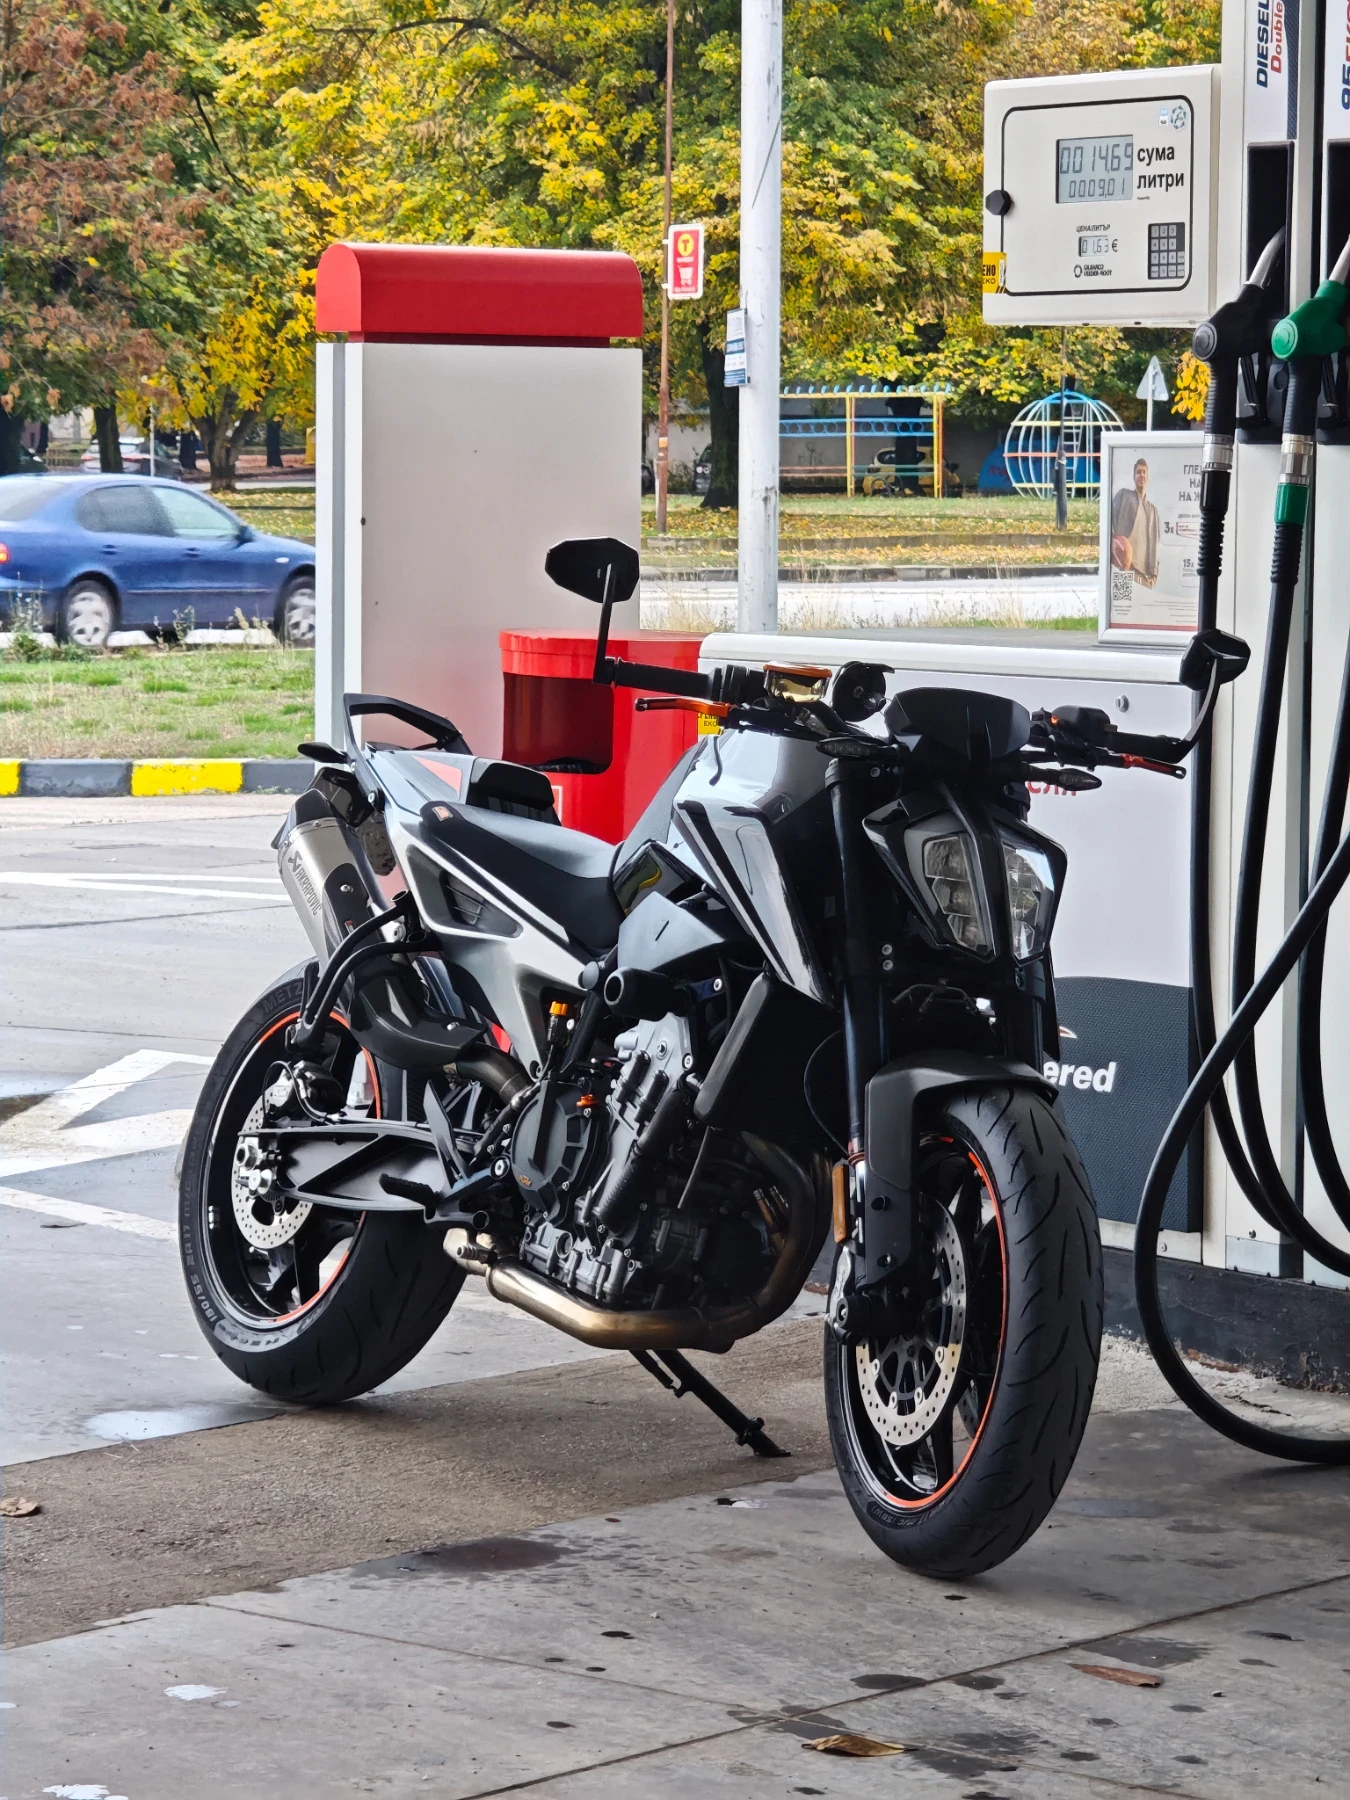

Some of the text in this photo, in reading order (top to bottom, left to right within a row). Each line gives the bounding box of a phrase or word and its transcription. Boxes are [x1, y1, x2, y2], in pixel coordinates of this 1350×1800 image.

[1257, 0, 1269, 88] DIESEL
[1271, 2, 1283, 73] Double
[1137, 146, 1175, 166] сума
[1137, 172, 1184, 192] литри
[1112, 239, 1118, 252] €
[1184, 464, 1201, 475] ГЛЕ
[1178, 491, 1191, 501] НА
